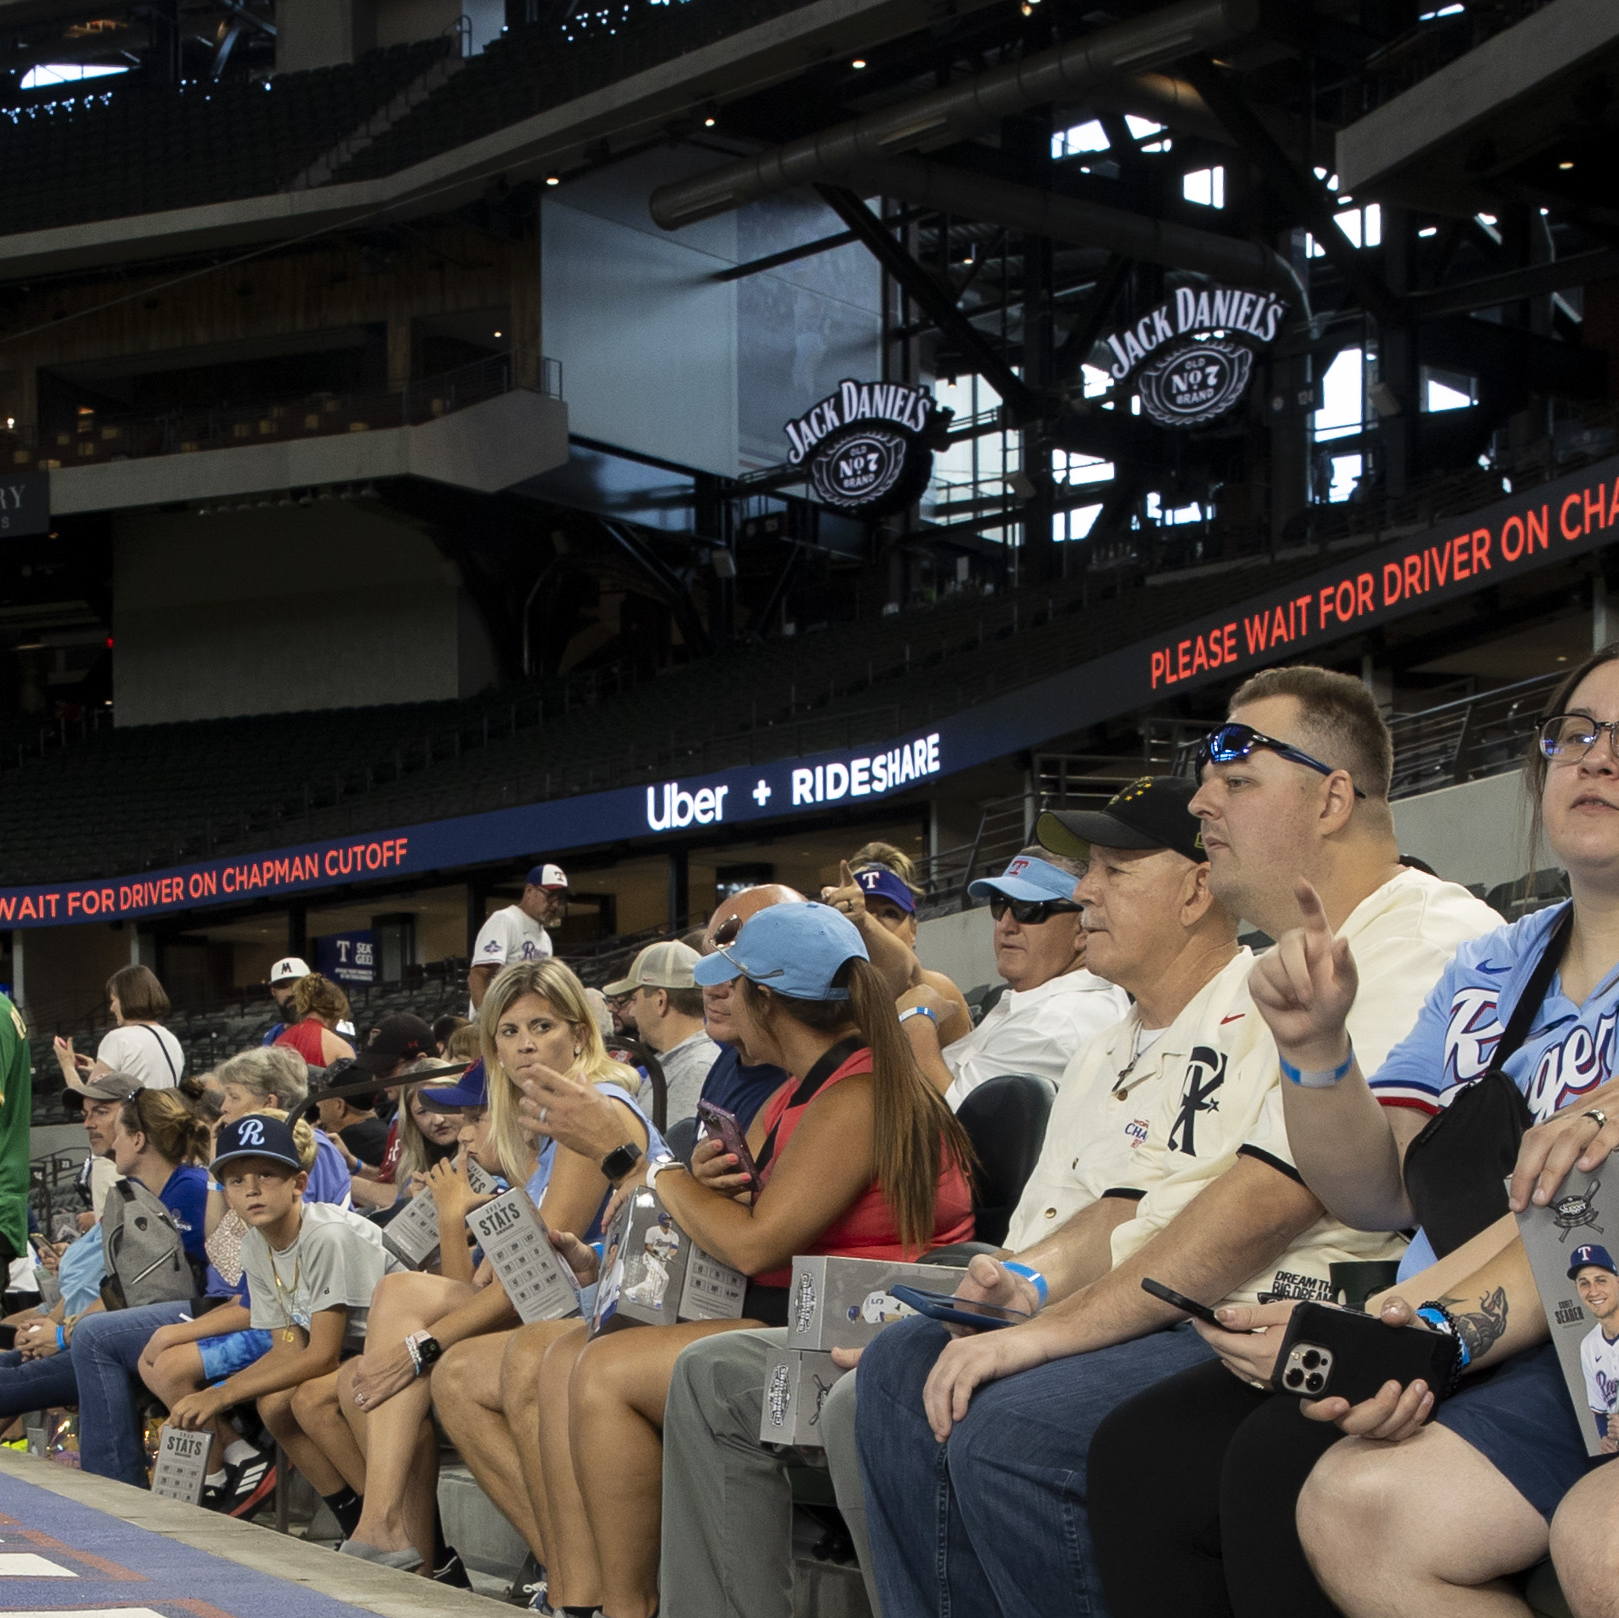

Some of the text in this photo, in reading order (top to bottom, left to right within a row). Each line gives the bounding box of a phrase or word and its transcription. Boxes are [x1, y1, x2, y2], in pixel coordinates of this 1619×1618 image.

[1107, 287, 1282, 379] JACK DANIEL'S
[1185, 358, 1205, 369] OLD
[1176, 389, 1214, 404] BRAND
[785, 381, 931, 464] JACK DANIEL'S
[843, 474, 875, 488] BRAND
[1151, 622, 1238, 688] PLEASE
[1245, 595, 1312, 655] WAIT
[1320, 573, 1375, 629] FOR
[1384, 528, 1491, 606] DRIVER
[1501, 505, 1548, 561] ON
[647, 782, 728, 831] Uber
[792, 733, 940, 805] RIDESHARE
[68, 887, 115, 916] FOR
[119, 877, 183, 911] DRIVER
[189, 872, 216, 898] ON
[222, 853, 319, 893] CHAPMAN
[325, 838, 408, 875] CUTOFF
[1009, 860, 1029, 875] T
[862, 872, 880, 889] T
[1443, 986, 1619, 1125] Rger
[238, 1119, 265, 1145] R
[1124, 1122, 1148, 1141] CHA
[479, 1202, 521, 1237] STATS
[1578, 1246, 1593, 1261] T
[1272, 1281, 1290, 1297] BIG
[1275, 1271, 1318, 1289] DREAM
[1554, 1306, 1585, 1325] SEAGER
[167, 1436, 202, 1456] STATS
